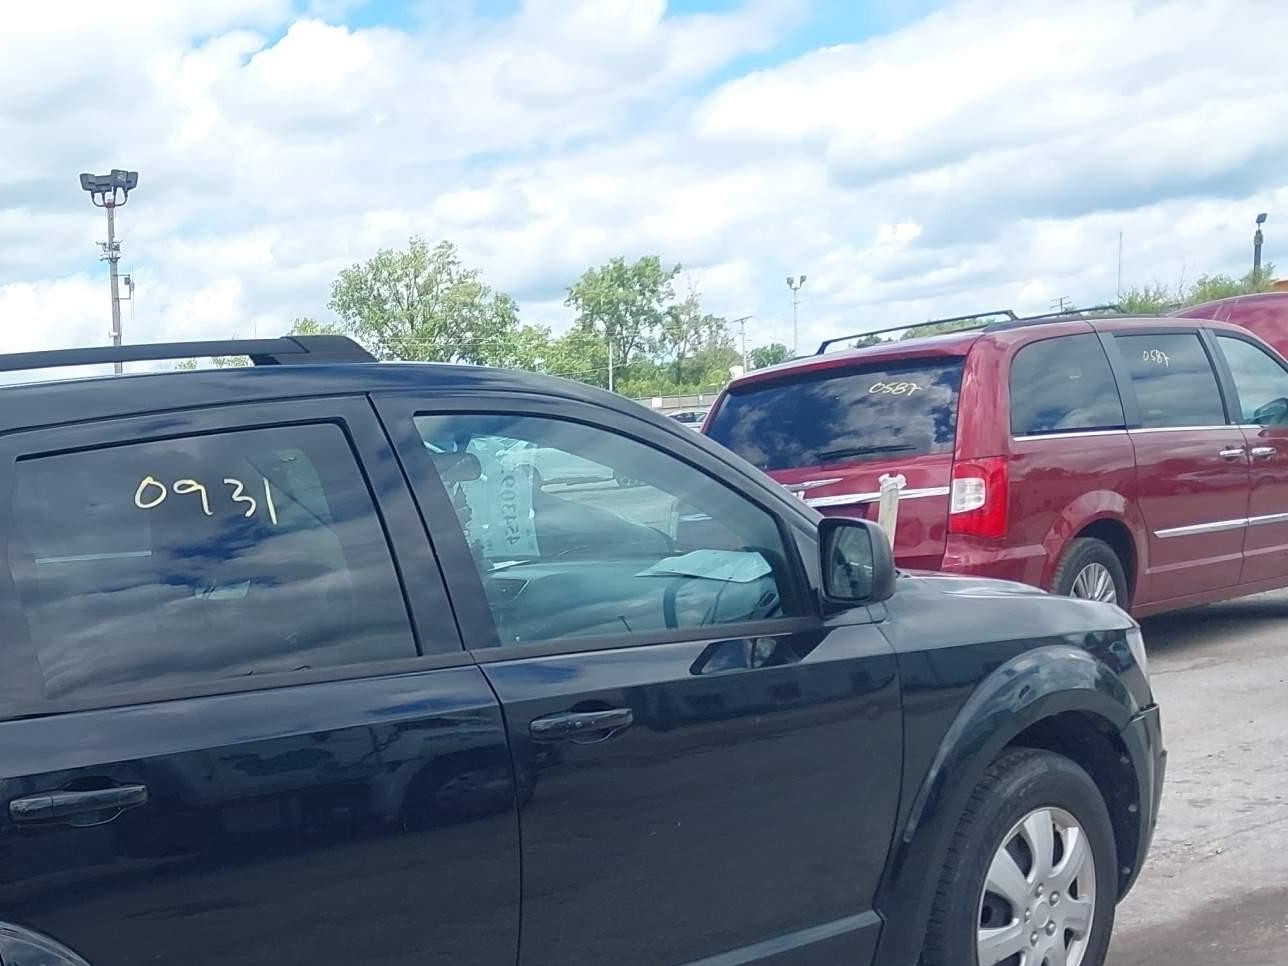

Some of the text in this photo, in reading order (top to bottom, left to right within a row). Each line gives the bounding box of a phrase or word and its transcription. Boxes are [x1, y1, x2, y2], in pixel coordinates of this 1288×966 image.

[1143, 345, 1170, 368] 0587
[868, 381, 923, 397] 0587
[134, 477, 278, 525] 0931
